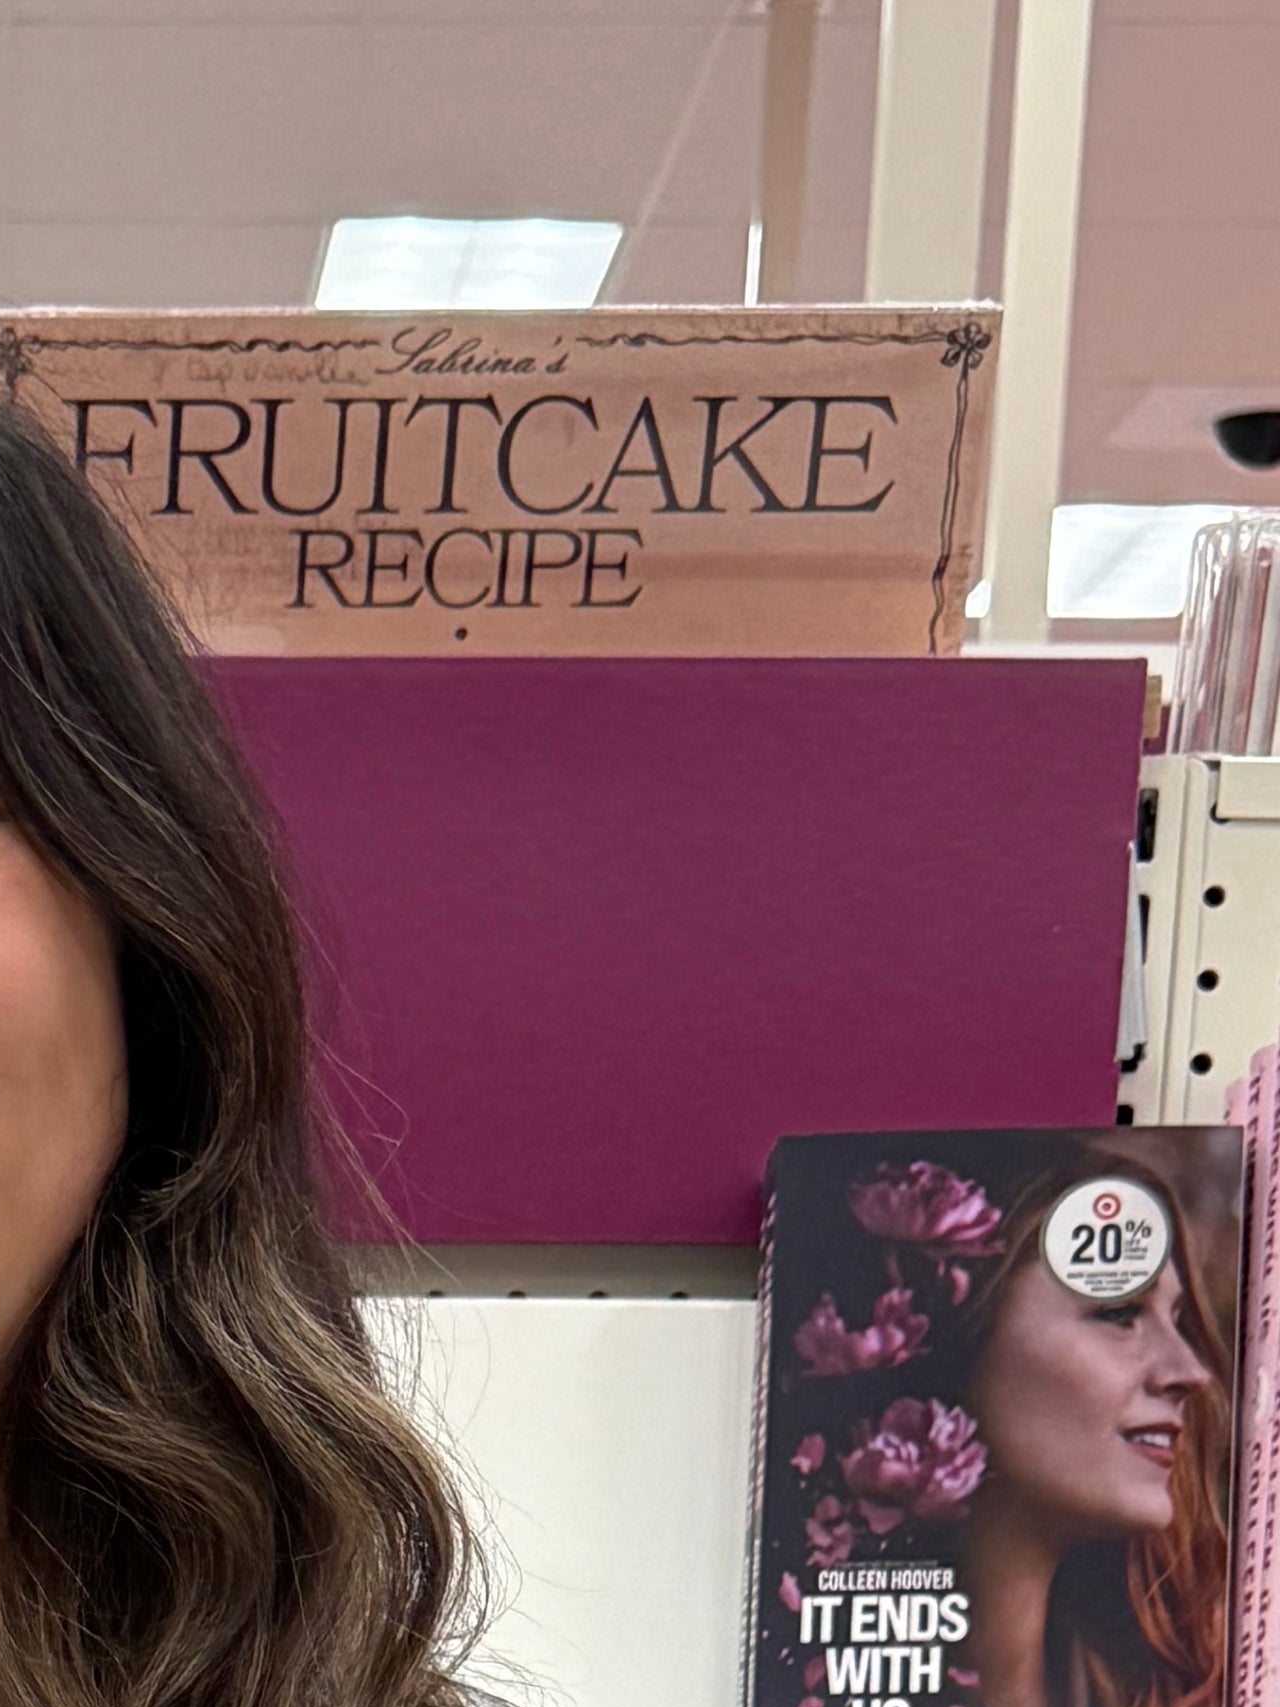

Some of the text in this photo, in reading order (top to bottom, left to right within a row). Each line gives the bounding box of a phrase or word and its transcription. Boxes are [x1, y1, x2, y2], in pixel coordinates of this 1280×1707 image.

[75, 396, 898, 516] FRUITCAKE
[289, 529, 643, 610] RECIPE
[1071, 1218, 1151, 1265] 20%
[819, 1569, 953, 1590] COLLEEN HOOVER
[800, 1594, 968, 1643] IT ENDS
[825, 1650, 939, 1694] WITH
